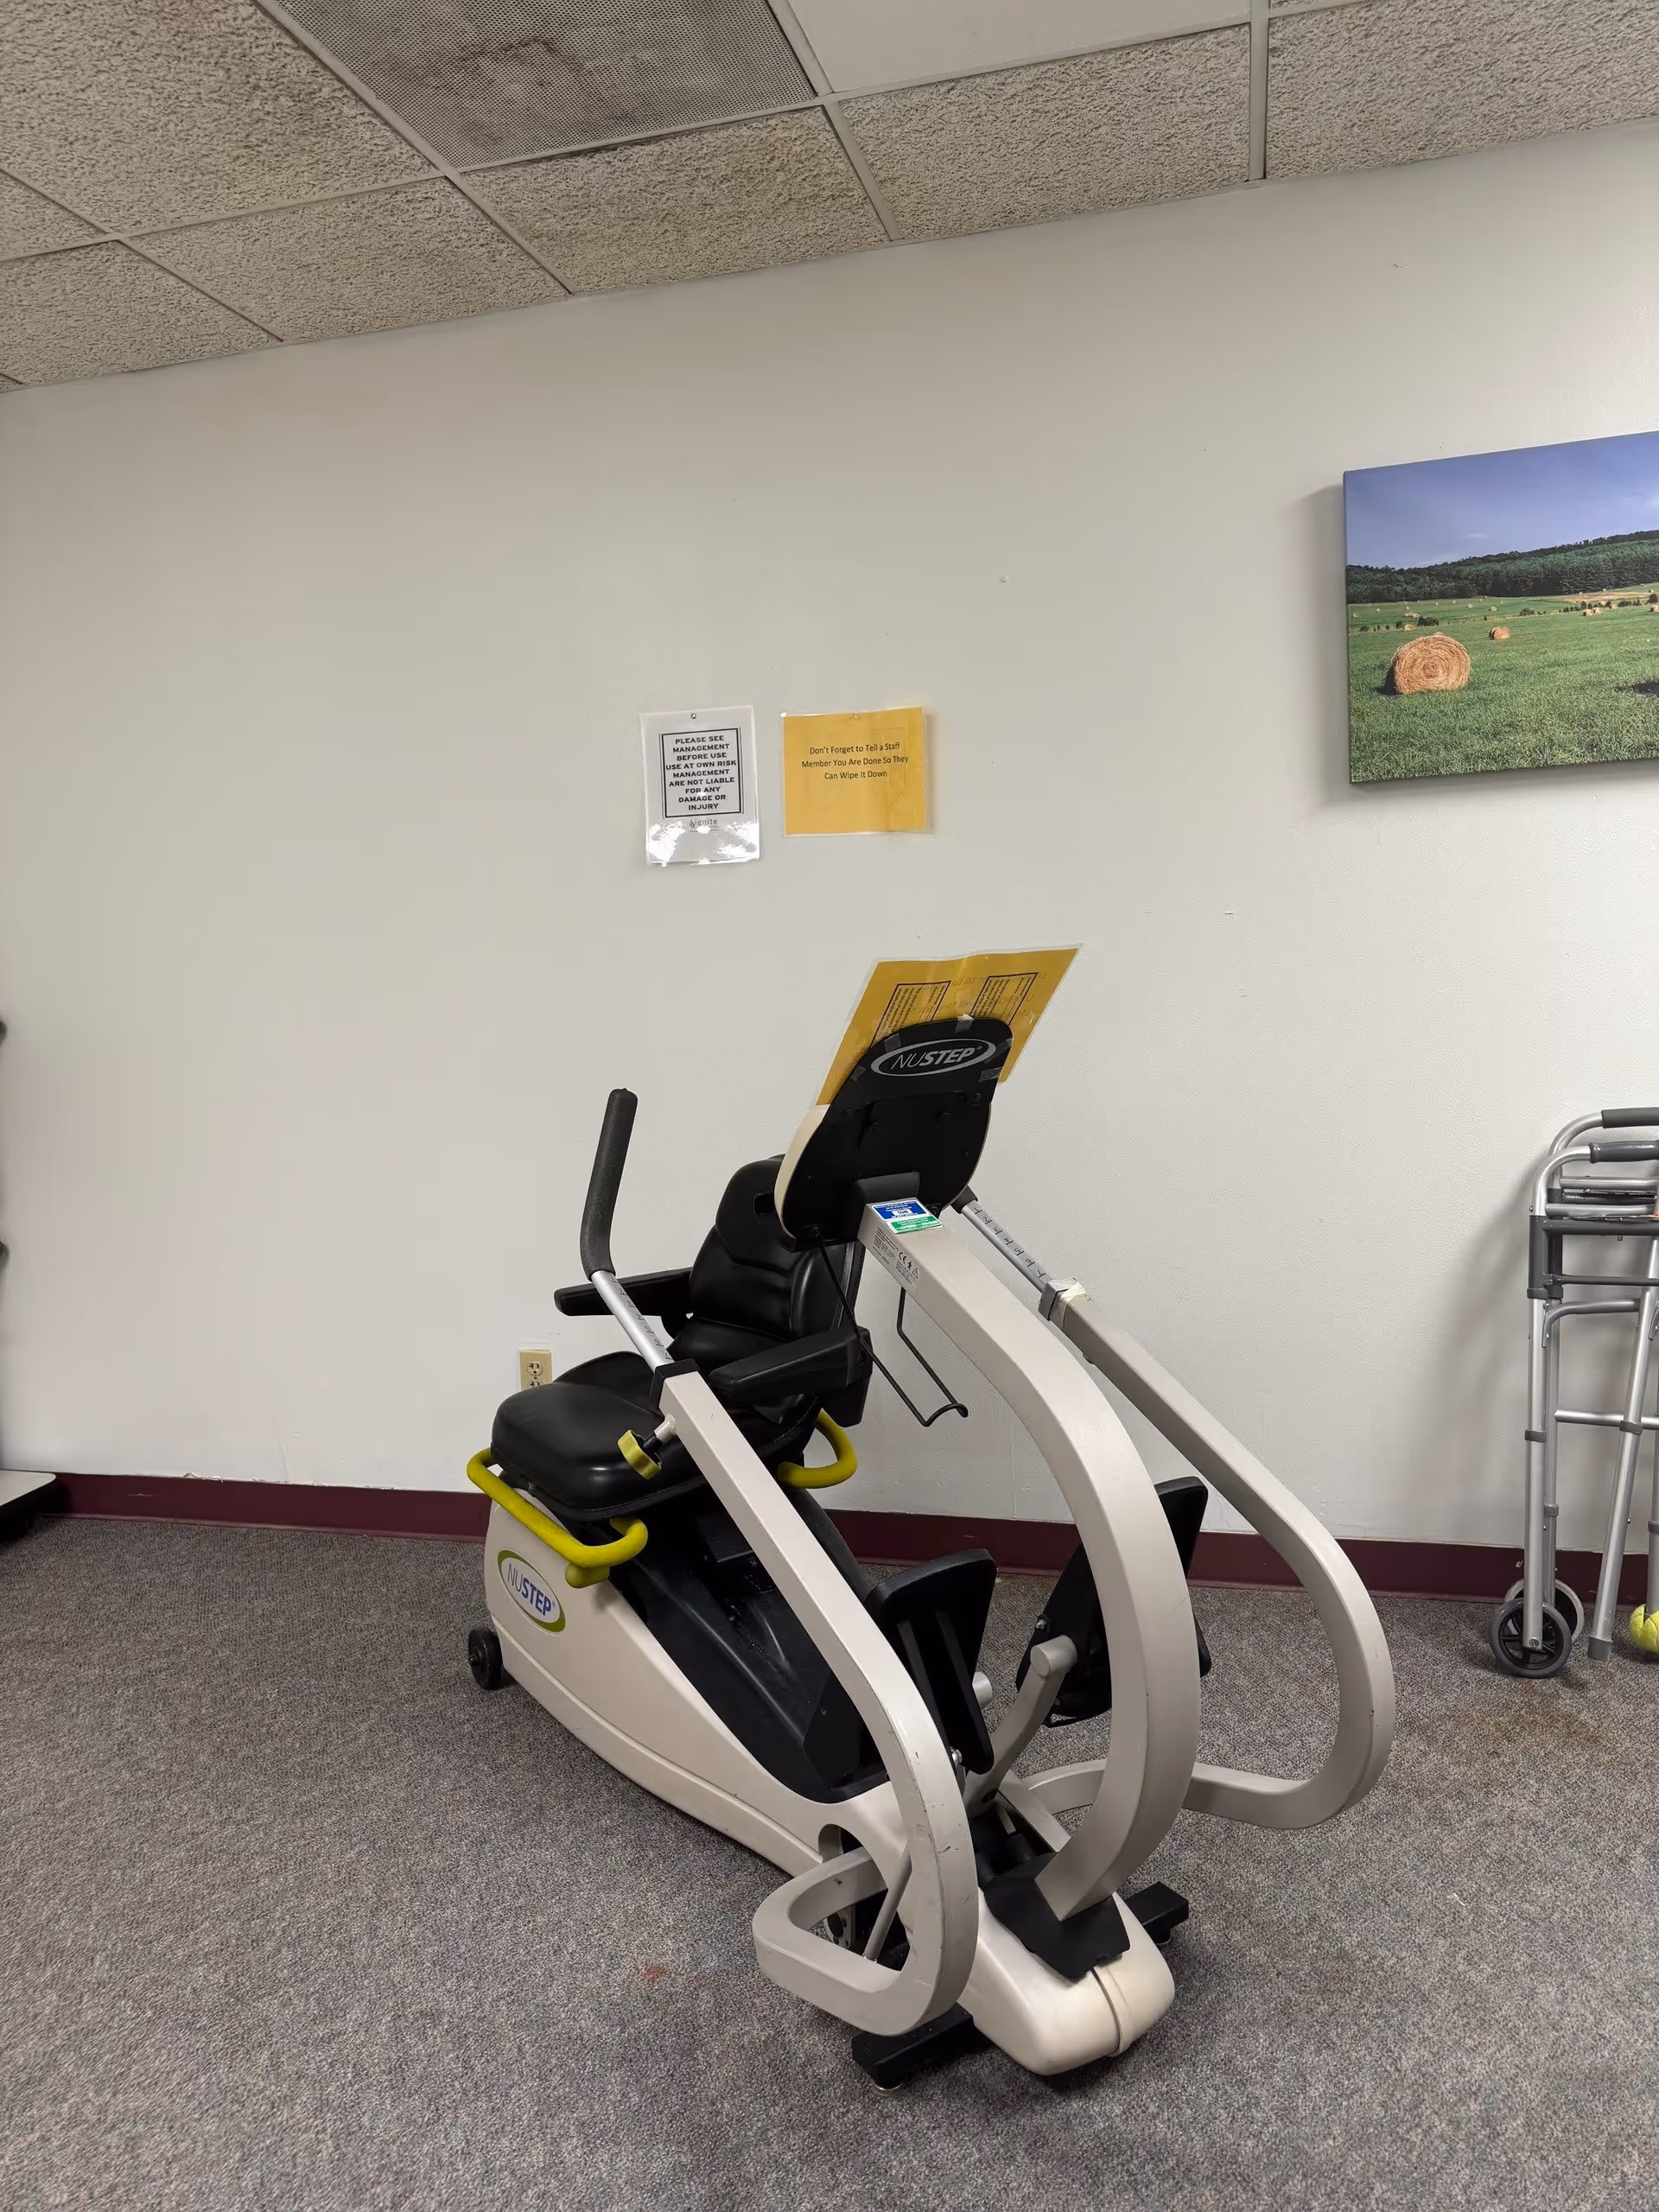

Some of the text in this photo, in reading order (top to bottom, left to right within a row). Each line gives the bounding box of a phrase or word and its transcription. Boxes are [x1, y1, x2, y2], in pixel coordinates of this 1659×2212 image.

[672, 743, 730, 753] MANAGEMENT
[830, 745, 854, 754] Forget
[885, 741, 900, 751] Staff
[893, 755, 909, 764] They
[672, 768, 730, 778] MANAGEMENT
[839, 771, 858, 780] Wipe
[678, 795, 713, 804] DAMAGE
[891, 1047, 976, 1071] NUSTEP
[507, 1562, 552, 1617] NUSTEP
